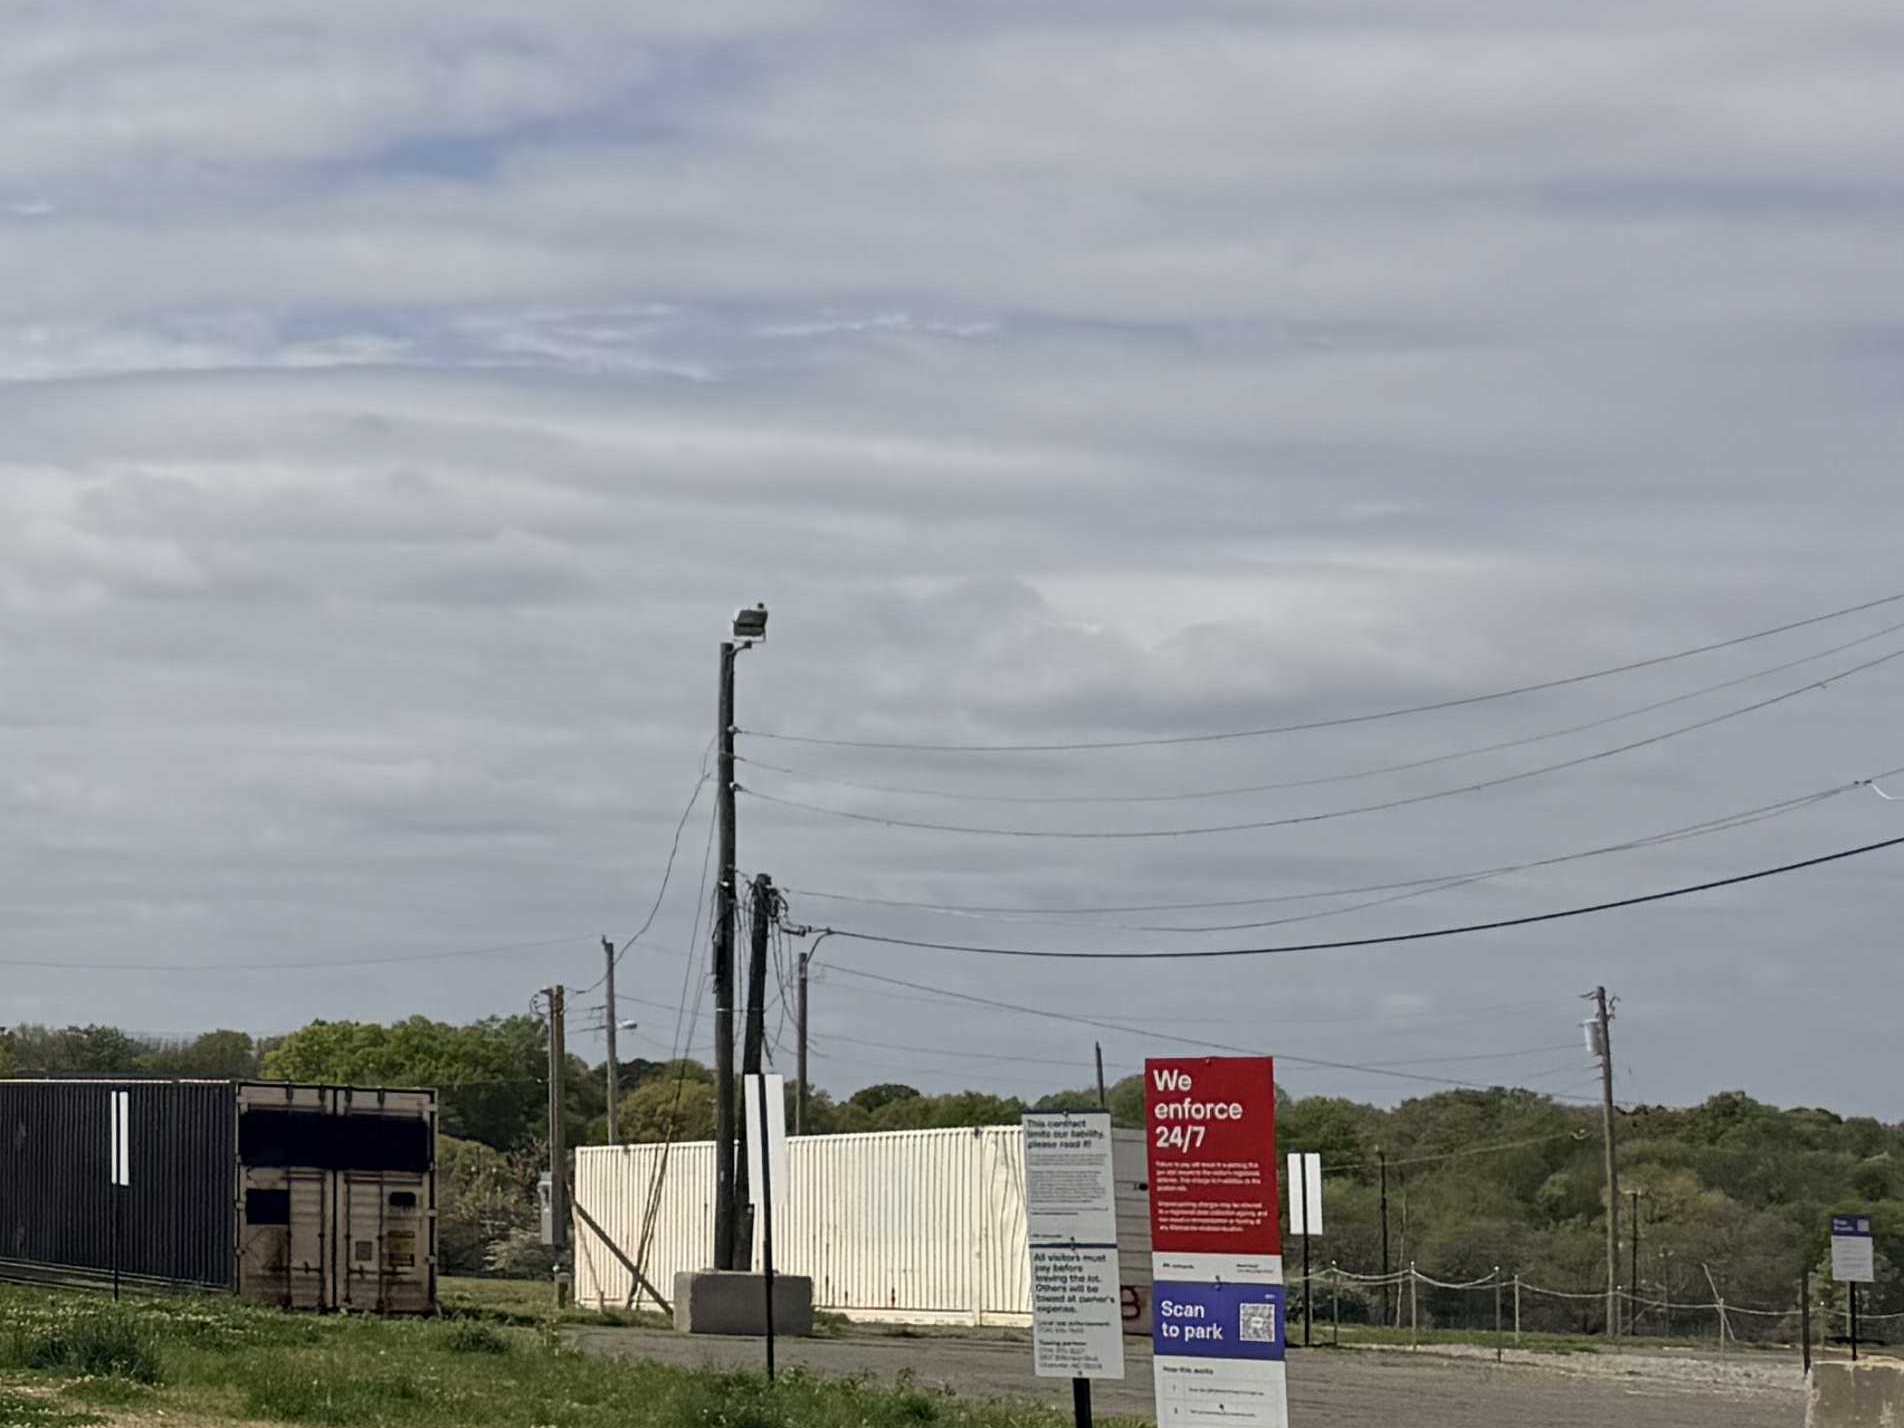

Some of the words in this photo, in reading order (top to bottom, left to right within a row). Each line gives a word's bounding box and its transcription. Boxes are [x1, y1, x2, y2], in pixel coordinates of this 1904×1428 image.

[1153, 1069, 1192, 1091] We
[1154, 1097, 1243, 1120] enforce
[1027, 1119, 1045, 1128] This
[1047, 1119, 1087, 1128] contract
[1155, 1124, 1206, 1153] 24/7
[1034, 1253, 1045, 1261] All
[1048, 1254, 1080, 1262] visitors
[1053, 1264, 1083, 1272] before
[1069, 1274, 1085, 1282] the
[1036, 1284, 1067, 1292] Others
[1069, 1284, 1085, 1292] will
[1087, 1285, 1099, 1293] be
[1036, 1295, 1065, 1303] towed
[1161, 1300, 1205, 1318] Scan
[1162, 1322, 1180, 1338] to
[1184, 1323, 1223, 1342] park
